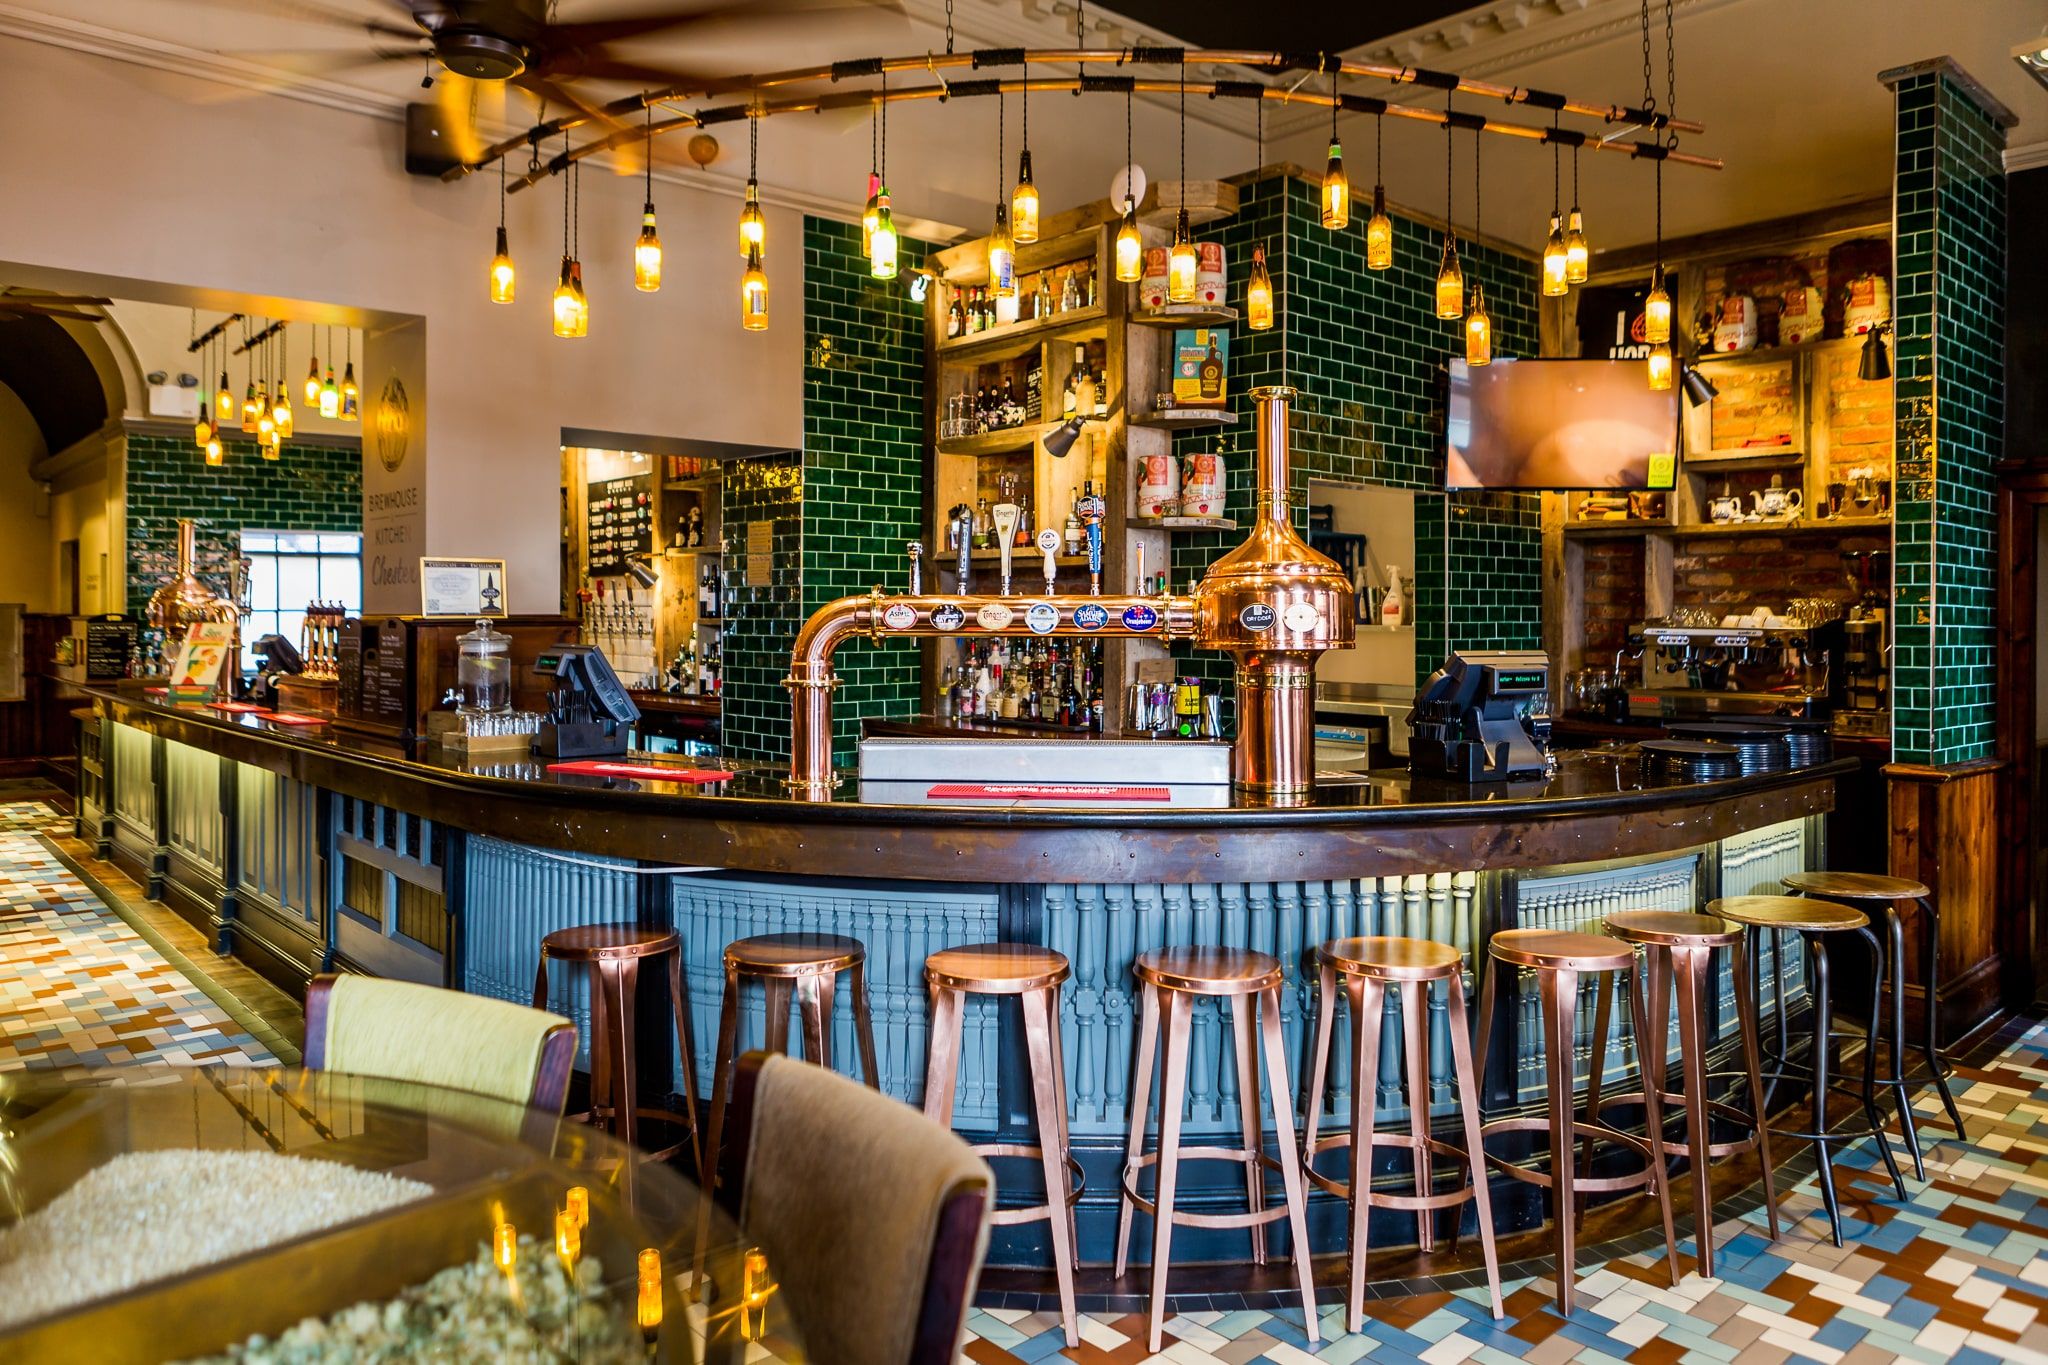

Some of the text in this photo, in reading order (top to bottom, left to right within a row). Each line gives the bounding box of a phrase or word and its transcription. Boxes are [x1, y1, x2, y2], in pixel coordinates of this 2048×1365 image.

[368, 487, 418, 512] BREWHOUSE
[374, 526, 412, 545] KITCHEN
[371, 554, 418, 586] Chester
